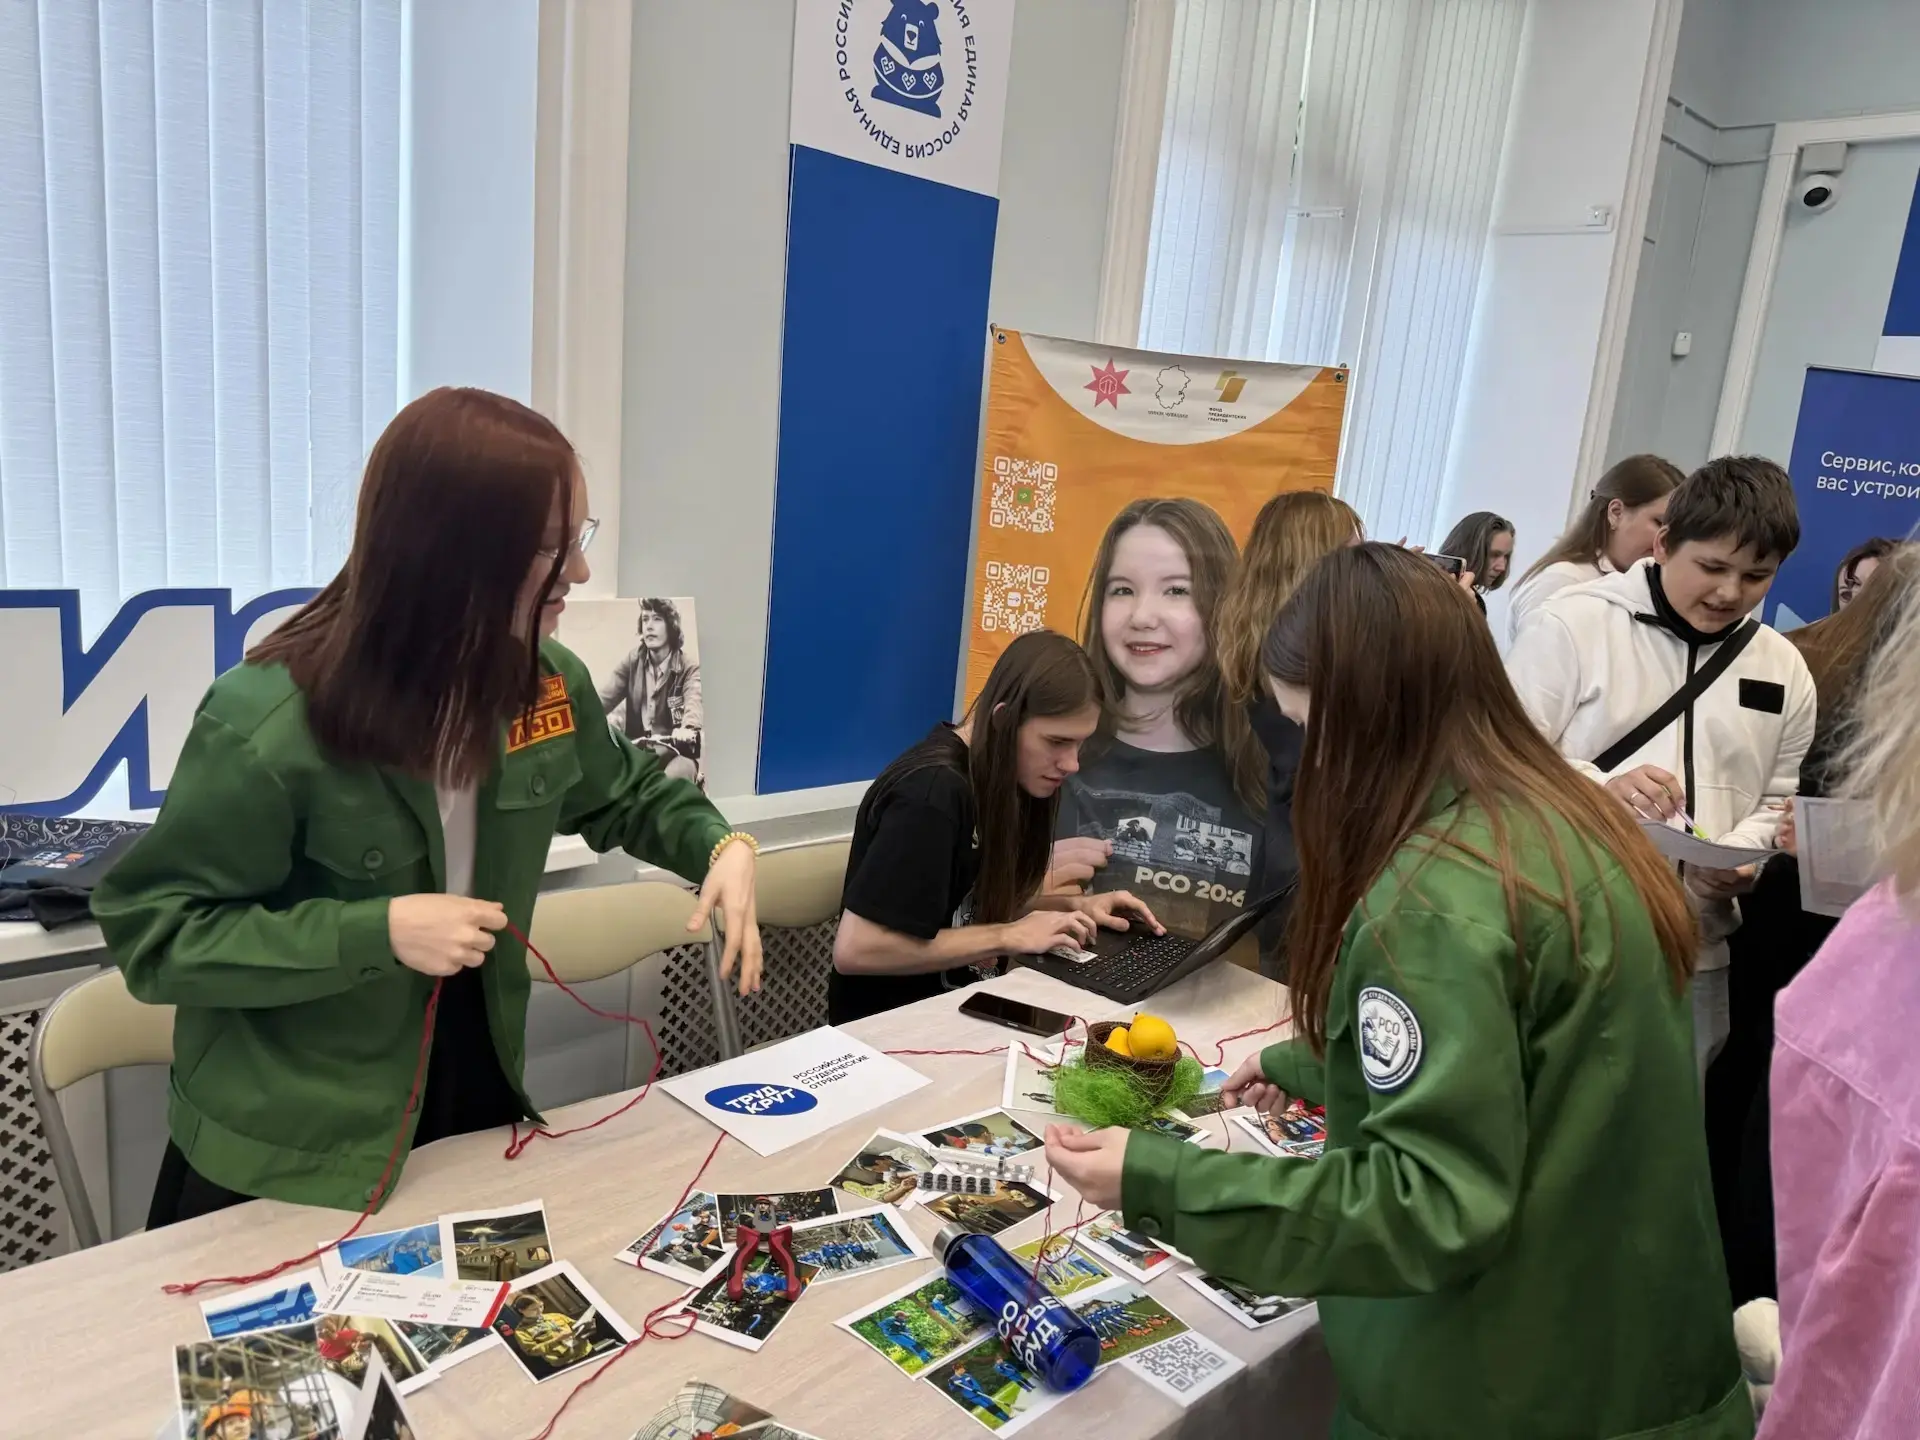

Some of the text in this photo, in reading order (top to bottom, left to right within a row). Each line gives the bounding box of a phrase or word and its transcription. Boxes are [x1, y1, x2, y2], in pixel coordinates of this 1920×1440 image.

[957, 35, 977, 122] ЕДИНАЯ
[845, 88, 900, 155] ЕДИНАЯ
[905, 121, 960, 158] РОССИЯ
[1821, 451, 1920, 477] Сервис, ко
[1816, 475, 1920, 500] вас устрои
[1134, 866, 1191, 894] РСО
[1379, 1017, 1400, 1036] РСО
[793, 1053, 856, 1080] РОССИЙСКИЕ
[801, 1054, 870, 1085] СТУДЕНЧЕСКИЕ
[809, 1072, 848, 1090] ОТРЯДЫ
[725, 1085, 780, 1109] ТРУД
[745, 1088, 796, 1114] КРУТ
